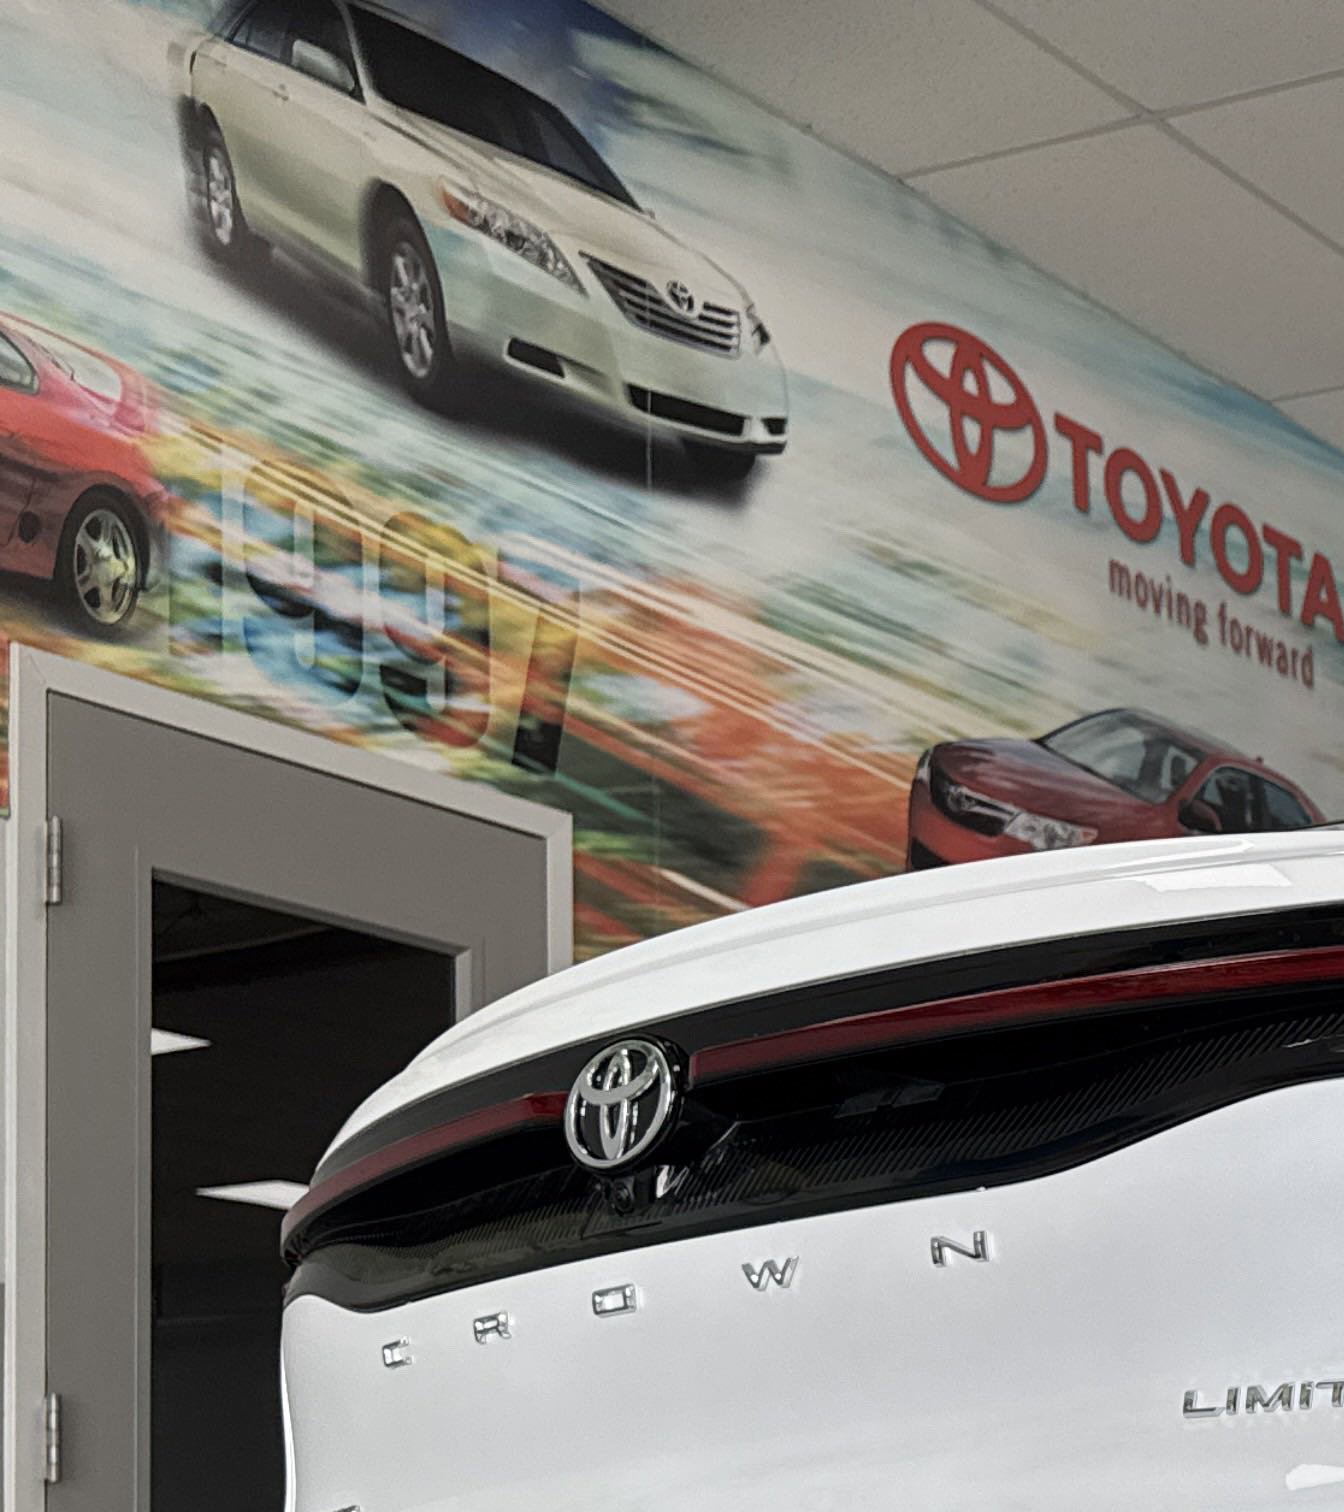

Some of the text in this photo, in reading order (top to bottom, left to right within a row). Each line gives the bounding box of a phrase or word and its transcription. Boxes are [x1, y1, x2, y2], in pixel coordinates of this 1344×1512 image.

[1109, 558, 1315, 689] moving forward
[381, 1230, 993, 1369] CROWN
